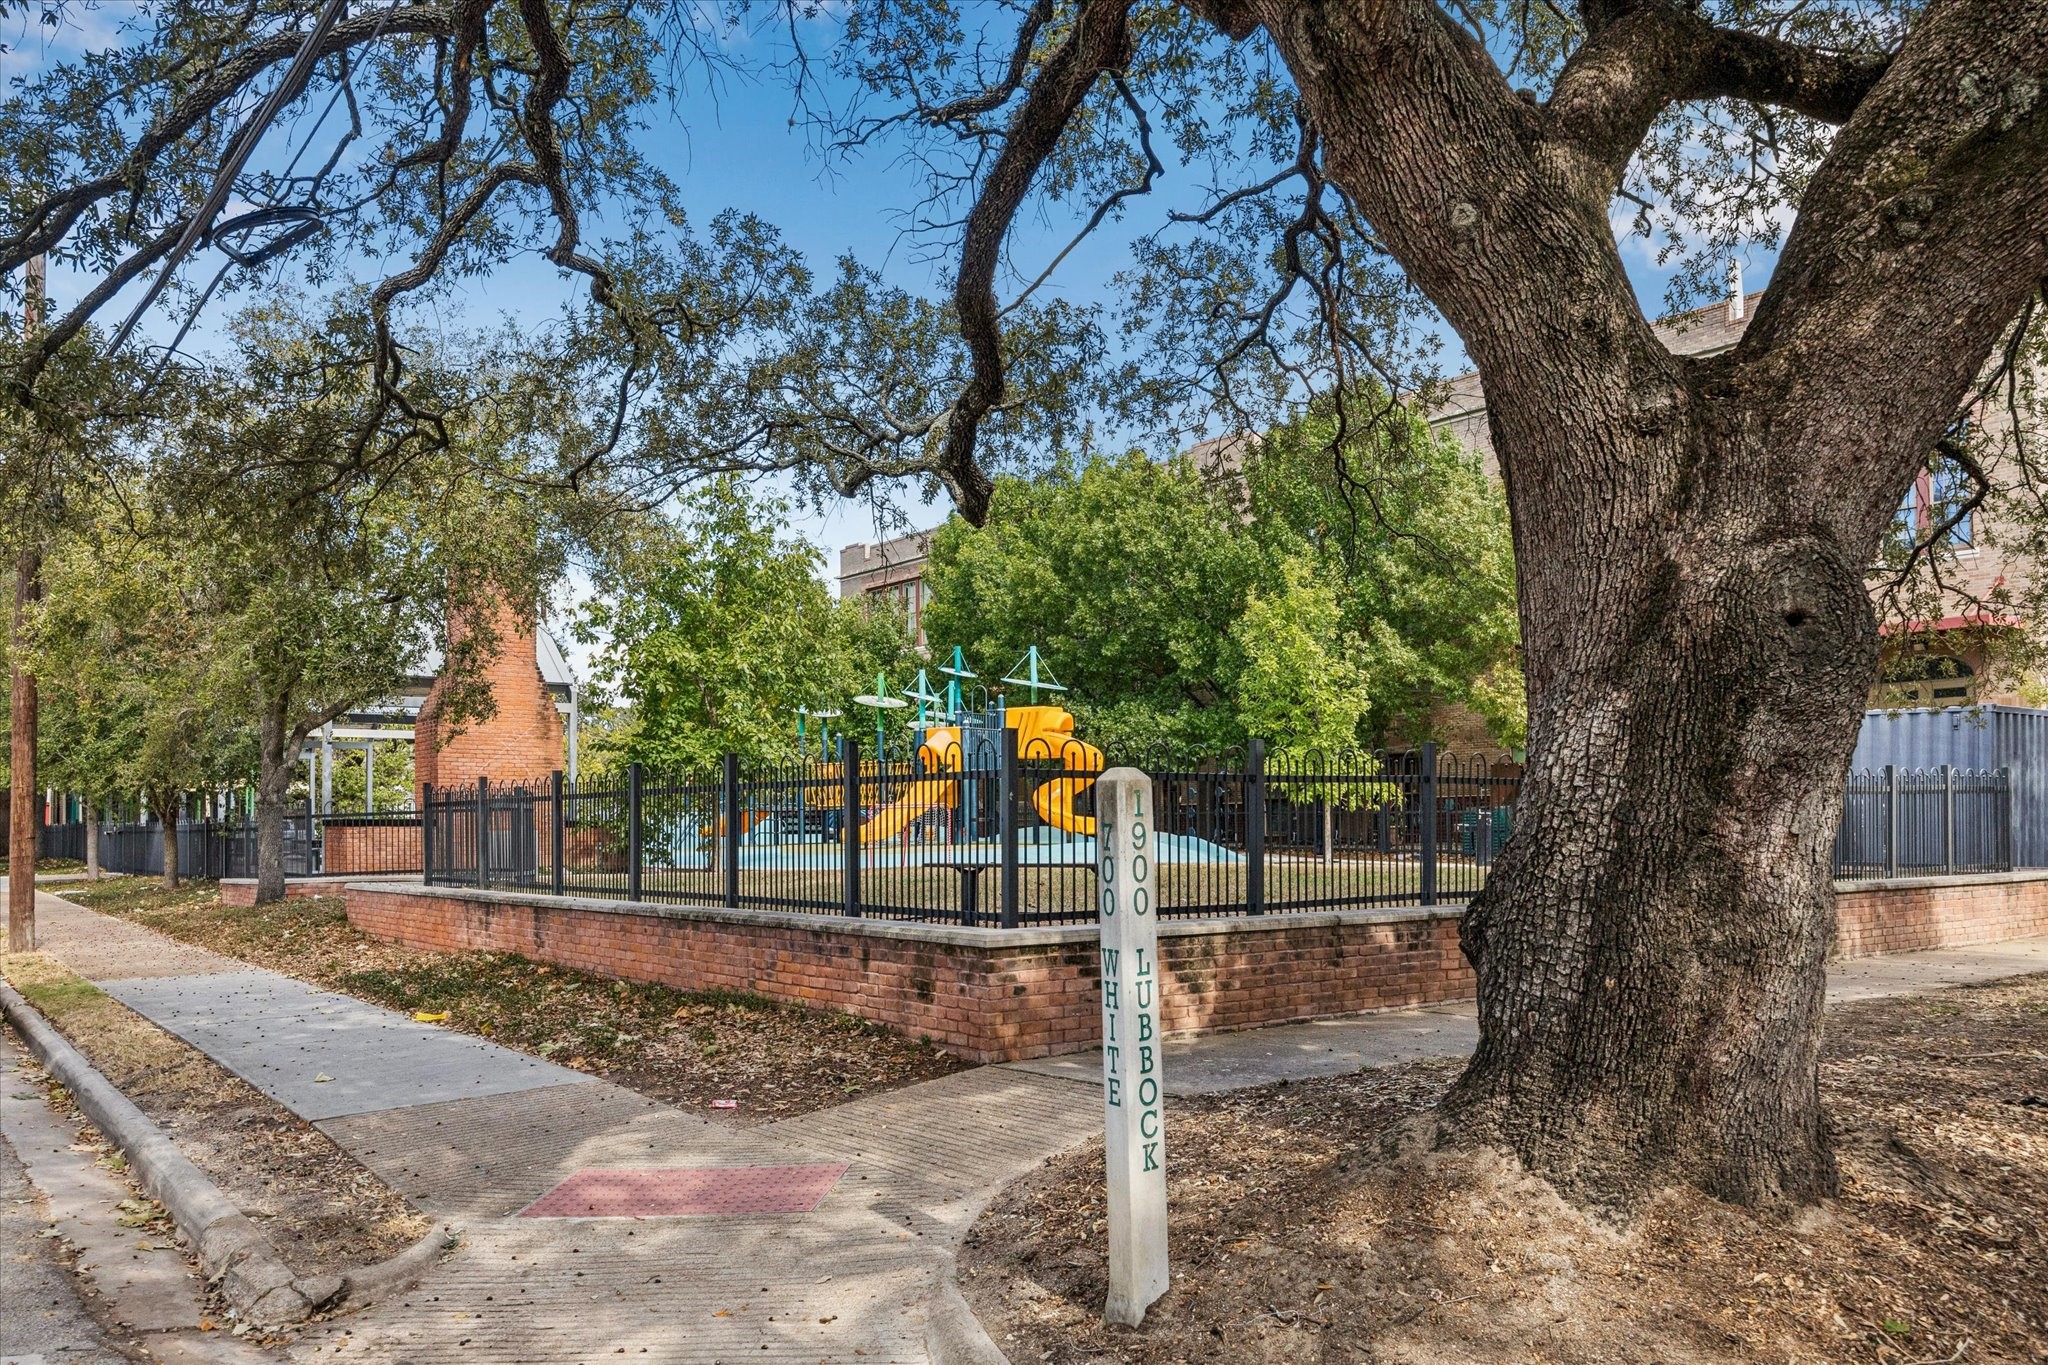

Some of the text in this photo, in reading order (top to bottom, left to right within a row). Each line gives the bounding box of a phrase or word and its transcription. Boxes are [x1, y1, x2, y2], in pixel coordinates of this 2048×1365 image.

[1102, 823, 1121, 1107] 700 WHITE
[1132, 790, 1159, 1172] 1900 LUBBOCK
